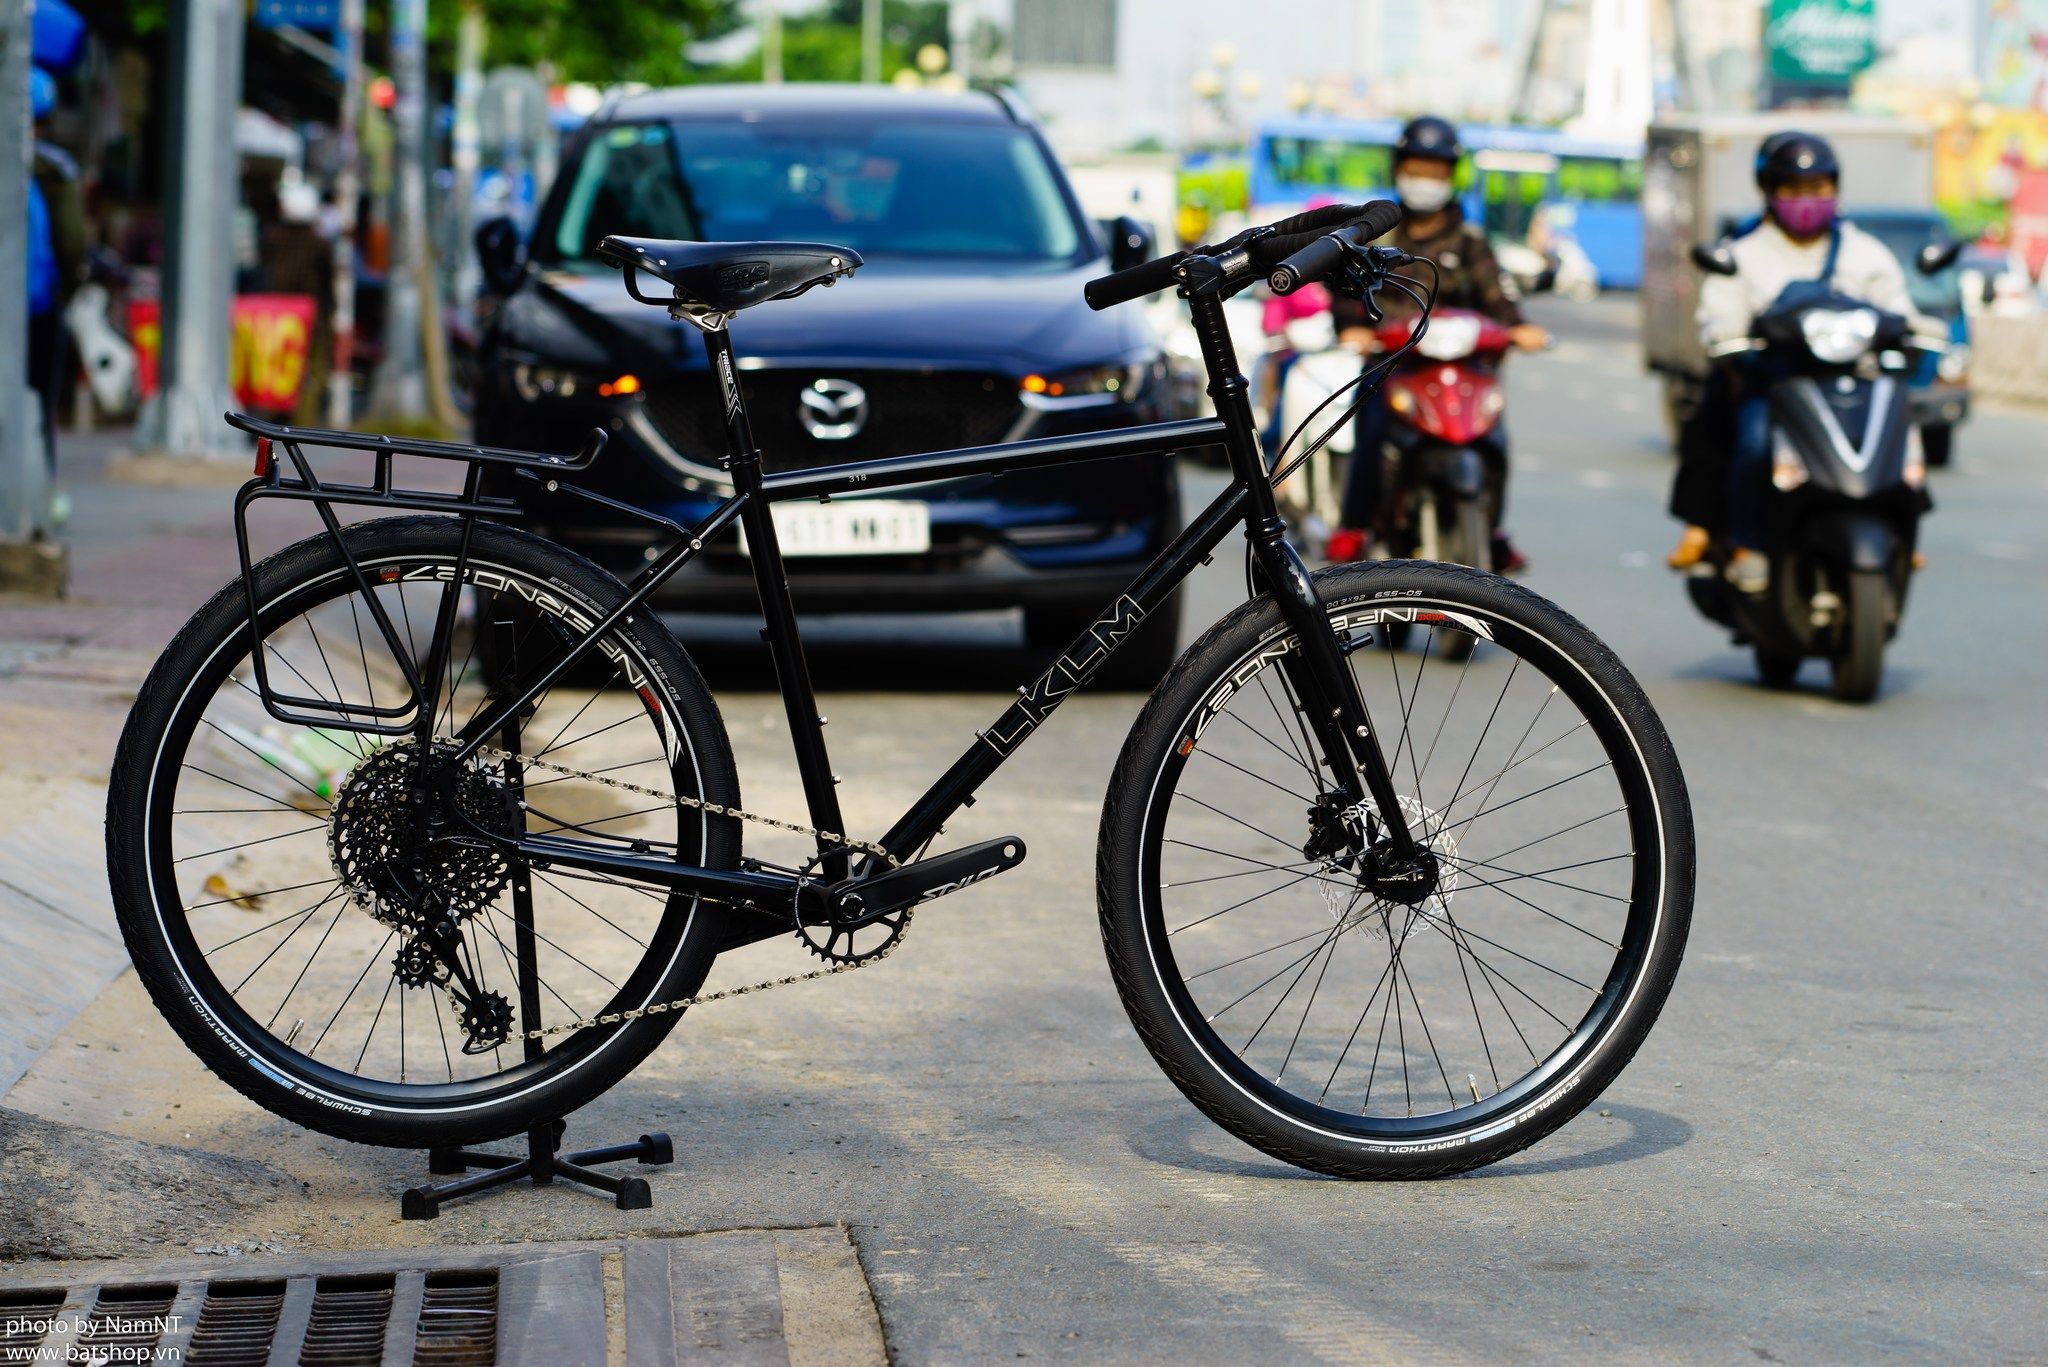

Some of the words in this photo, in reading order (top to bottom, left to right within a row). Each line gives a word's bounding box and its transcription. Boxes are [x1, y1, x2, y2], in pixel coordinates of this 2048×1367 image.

[848, 473, 868, 483] 318
[402, 565, 469, 583] 27
[1374, 589, 1423, 599] 50-559
[620, 624, 647, 651] 26x2.0
[649, 657, 682, 702] 50-559
[984, 593, 1146, 757] LKLM
[1193, 681, 1235, 740] 27
[188, 996, 249, 1059] MARATHON
[296, 1087, 373, 1117] SCHWALBE
[1519, 1074, 1582, 1124] SCHWALBE
[1388, 1137, 1467, 1154] MARATHON
